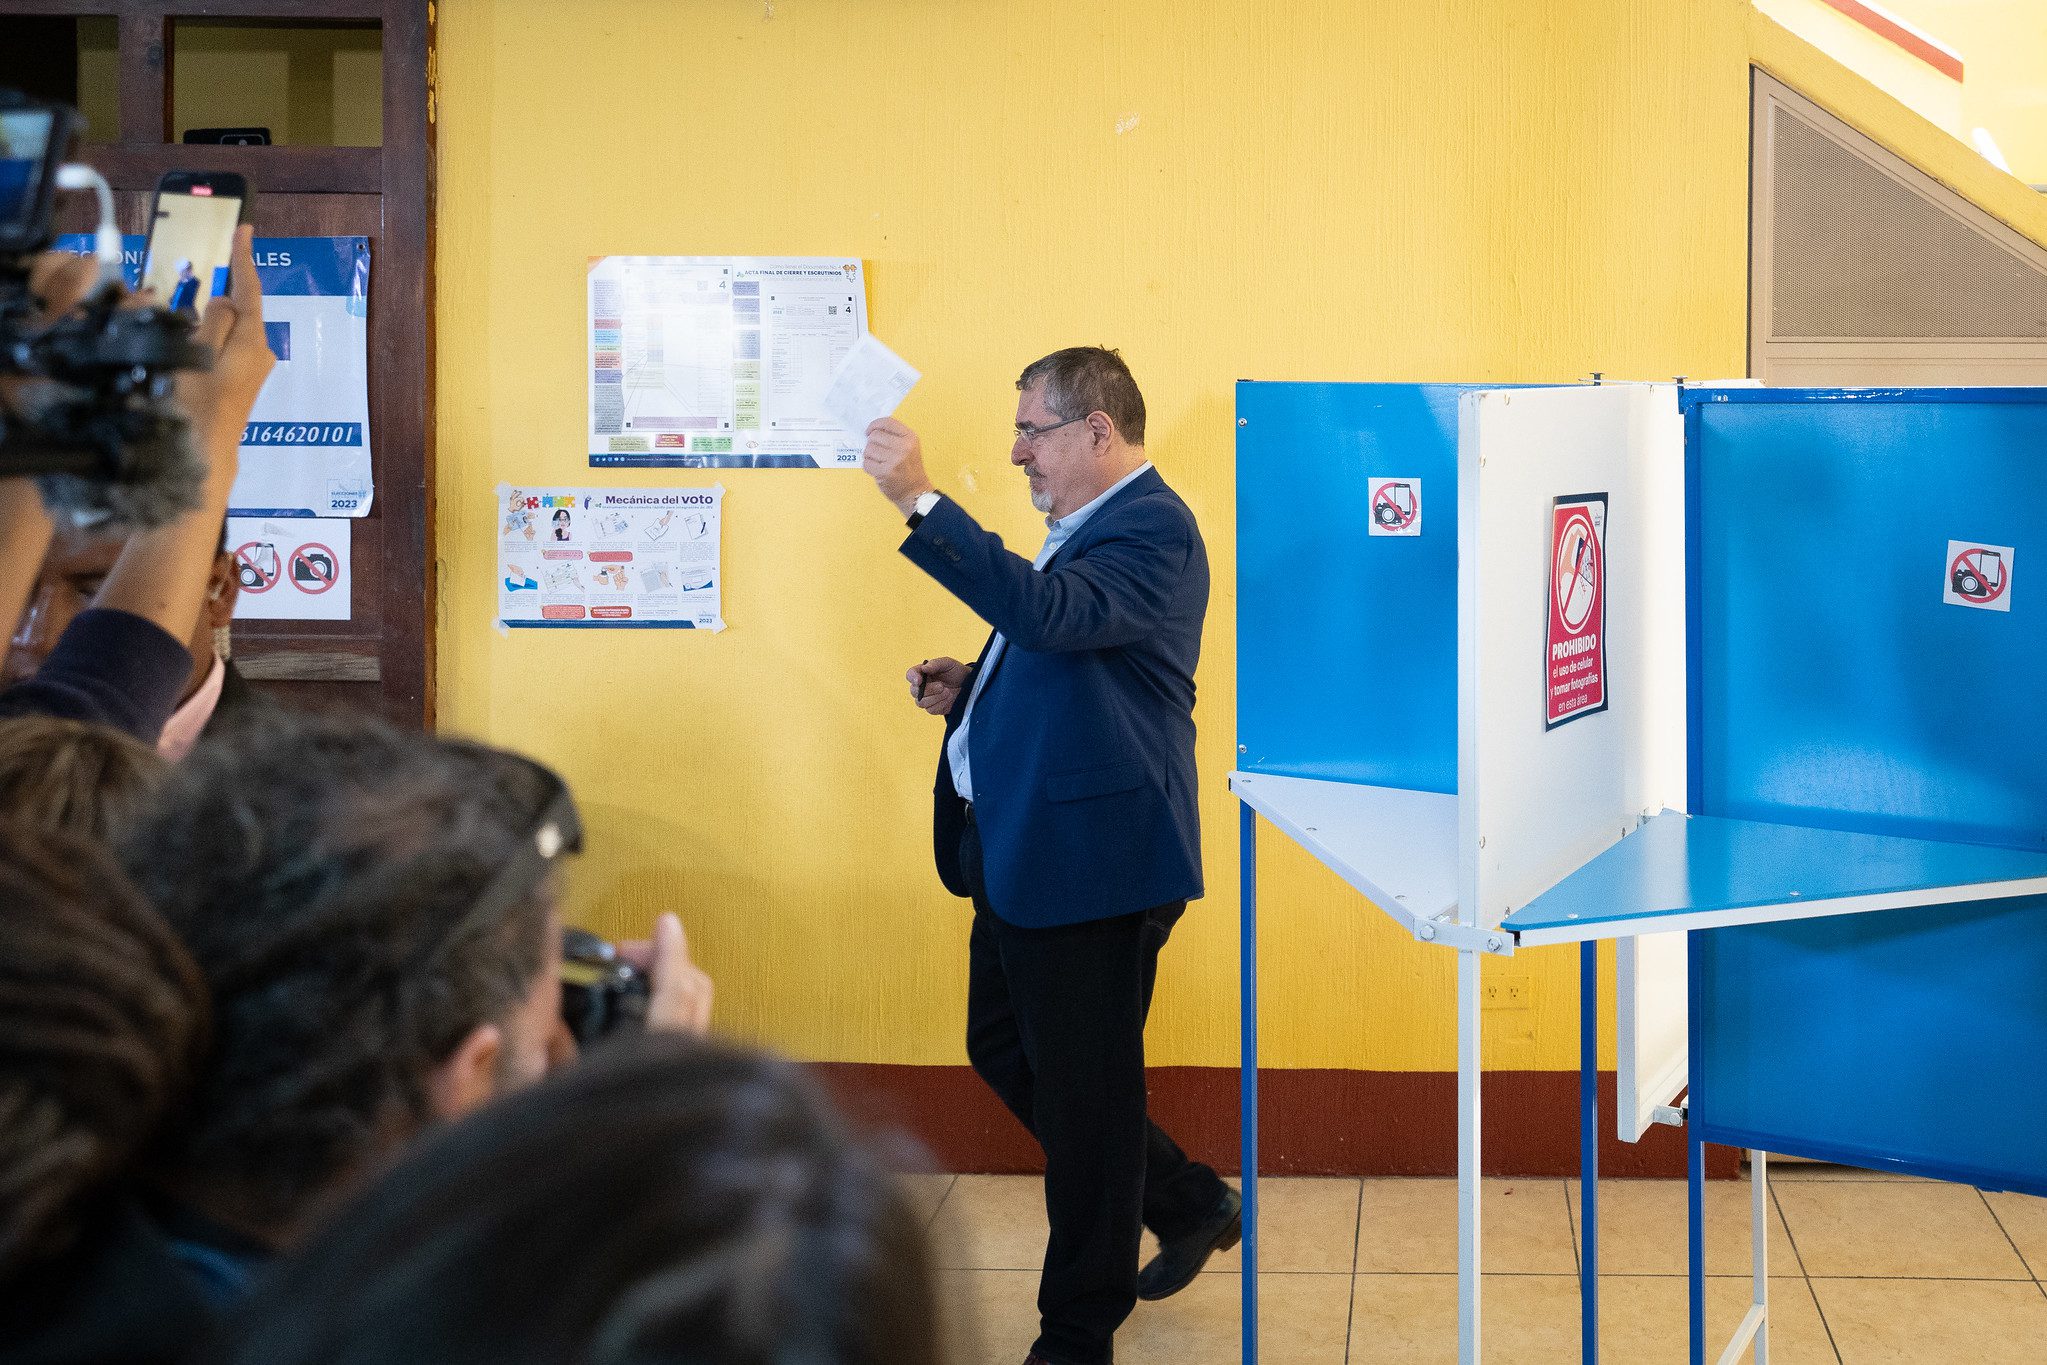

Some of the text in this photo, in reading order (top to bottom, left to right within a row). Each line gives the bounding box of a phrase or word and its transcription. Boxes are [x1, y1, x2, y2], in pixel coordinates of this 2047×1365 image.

[331, 499, 358, 508] 2023
[605, 494, 714, 504] Mecánica del voto
[1552, 633, 1597, 661] PROHIBIDO
[1552, 656, 1594, 678] el uso de celular
[1549, 687, 1554, 700] y
[1554, 681, 1571, 696] tomar
[1558, 702, 1566, 713] en
[1566, 696, 1577, 710] esta
